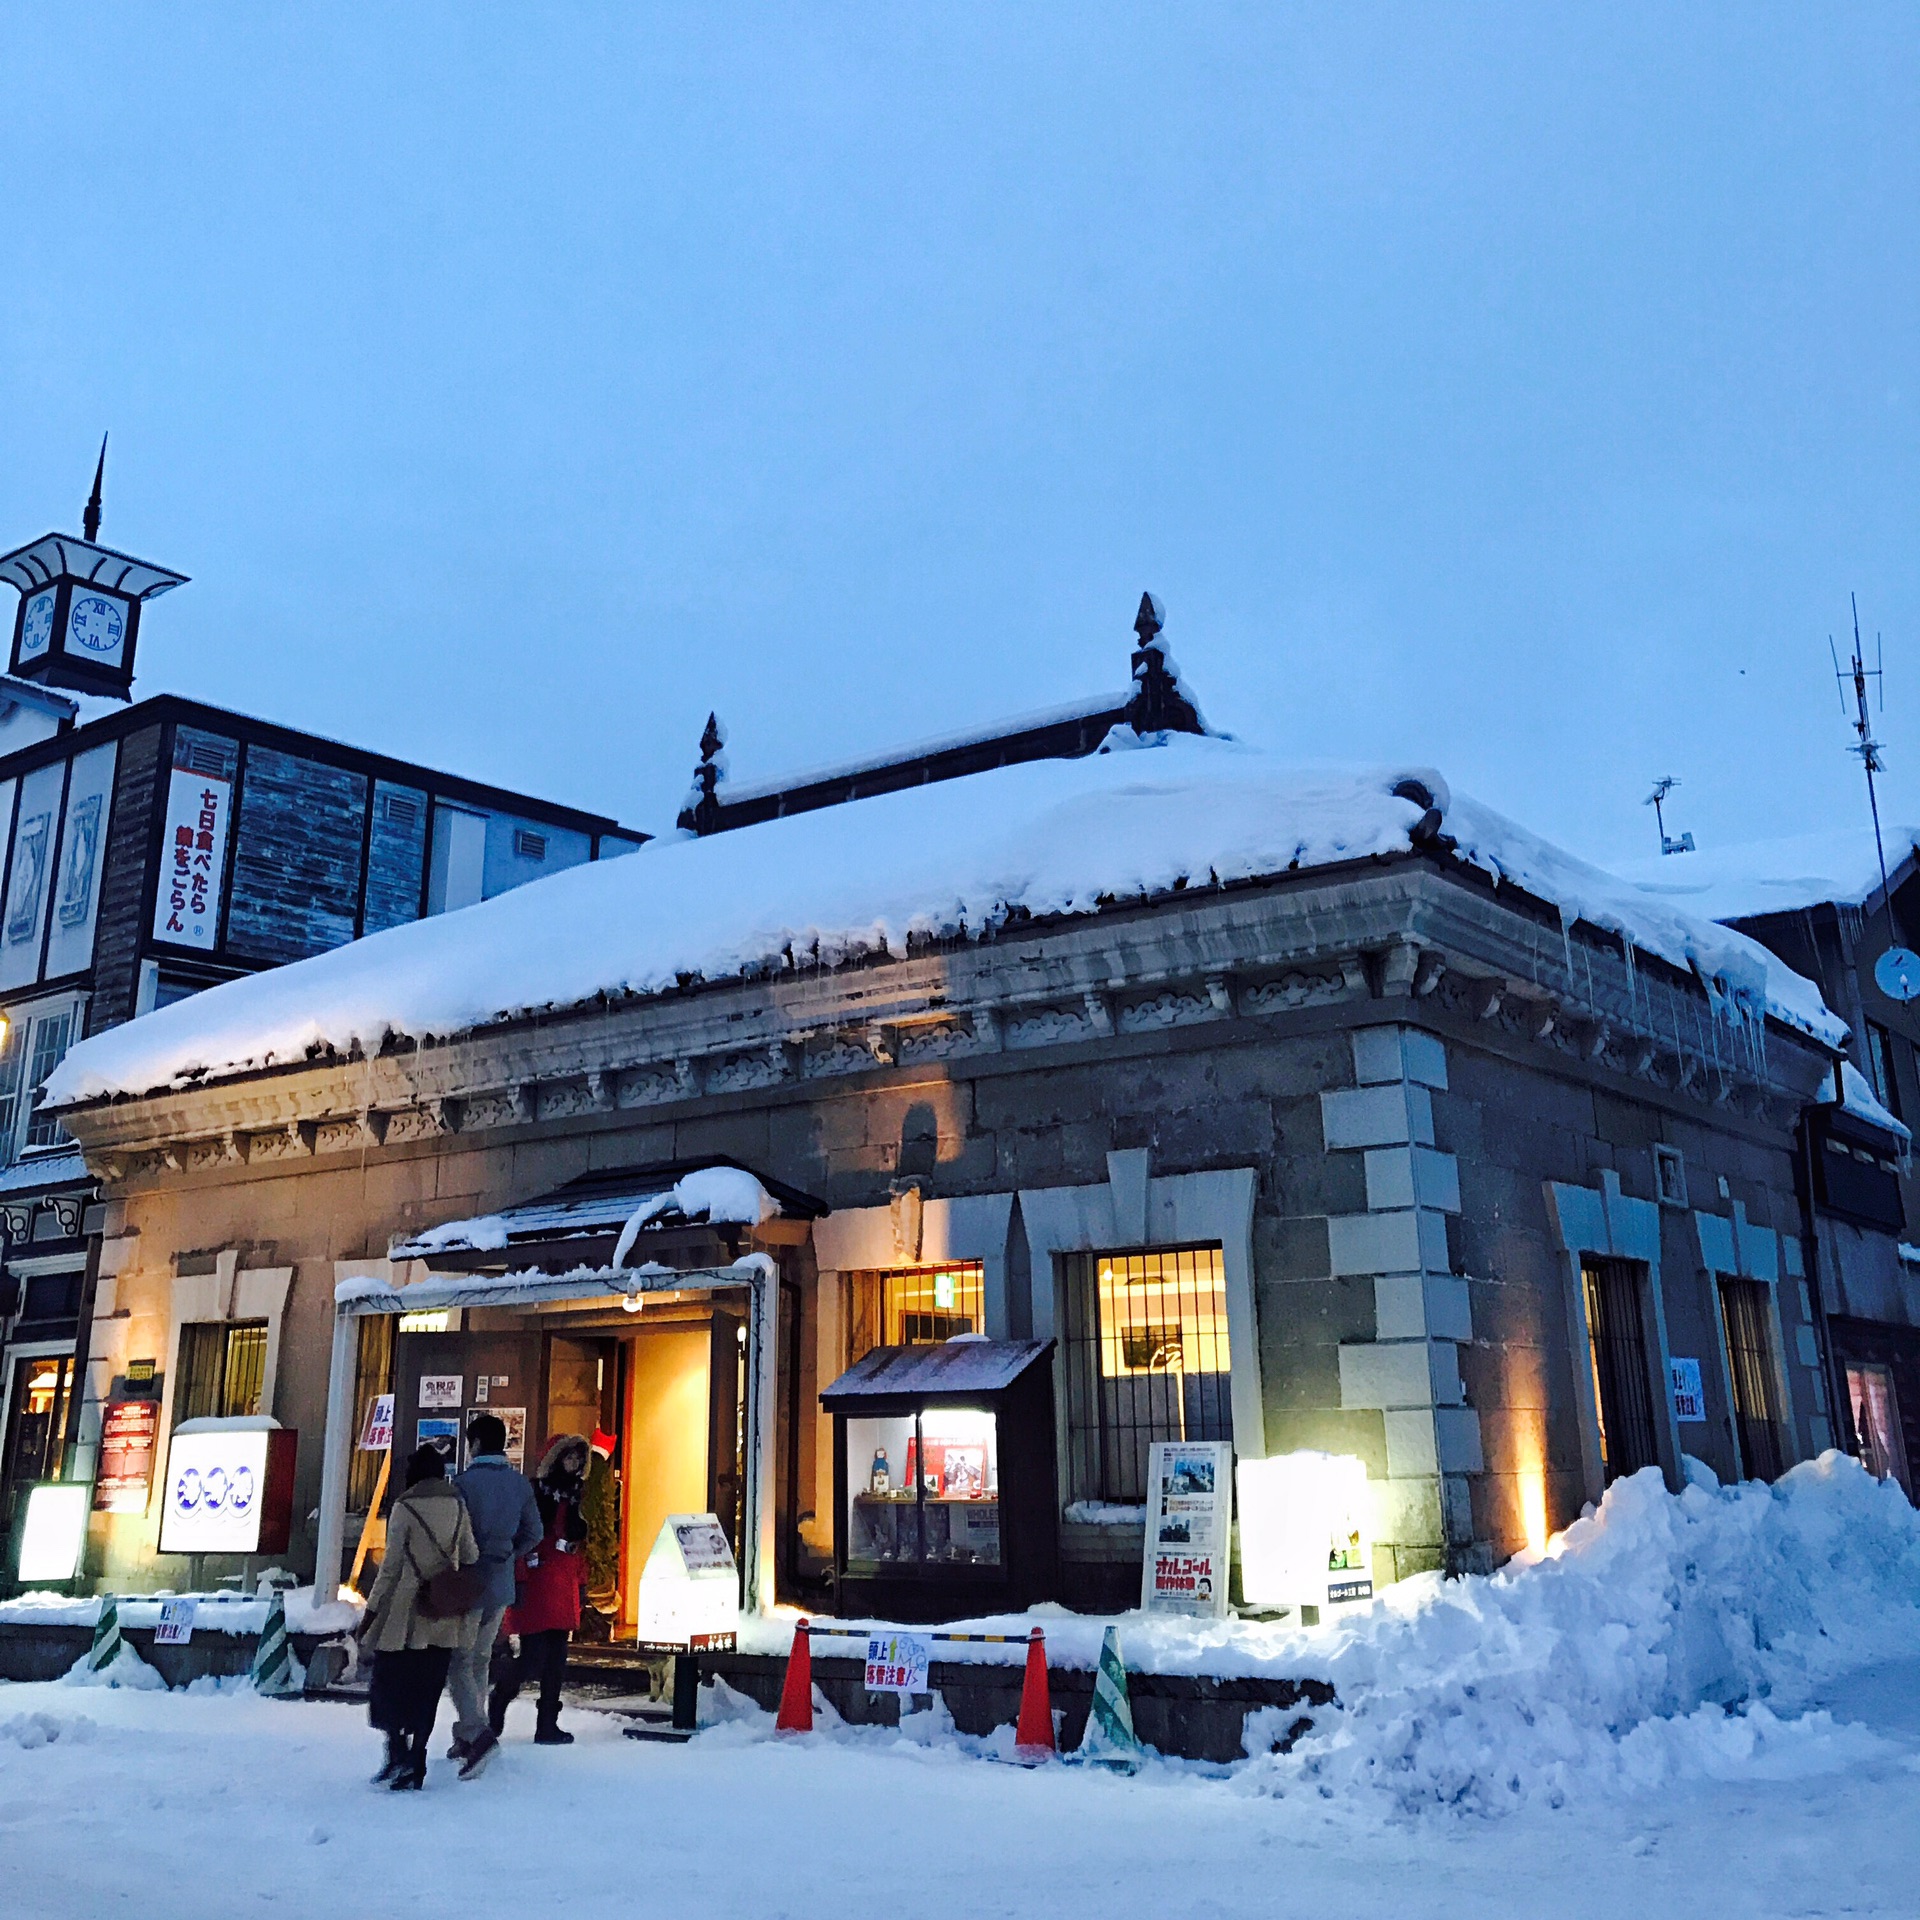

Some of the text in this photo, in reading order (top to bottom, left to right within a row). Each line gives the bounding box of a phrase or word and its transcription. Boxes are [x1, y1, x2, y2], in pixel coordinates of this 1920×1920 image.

[93, 601, 106, 616] XII
[107, 622, 120, 637] III
[190, 788, 218, 914] 七日食べたら
[1155, 1556, 1212, 1575] オルゴール
[868, 1641, 888, 1660] 頭上
